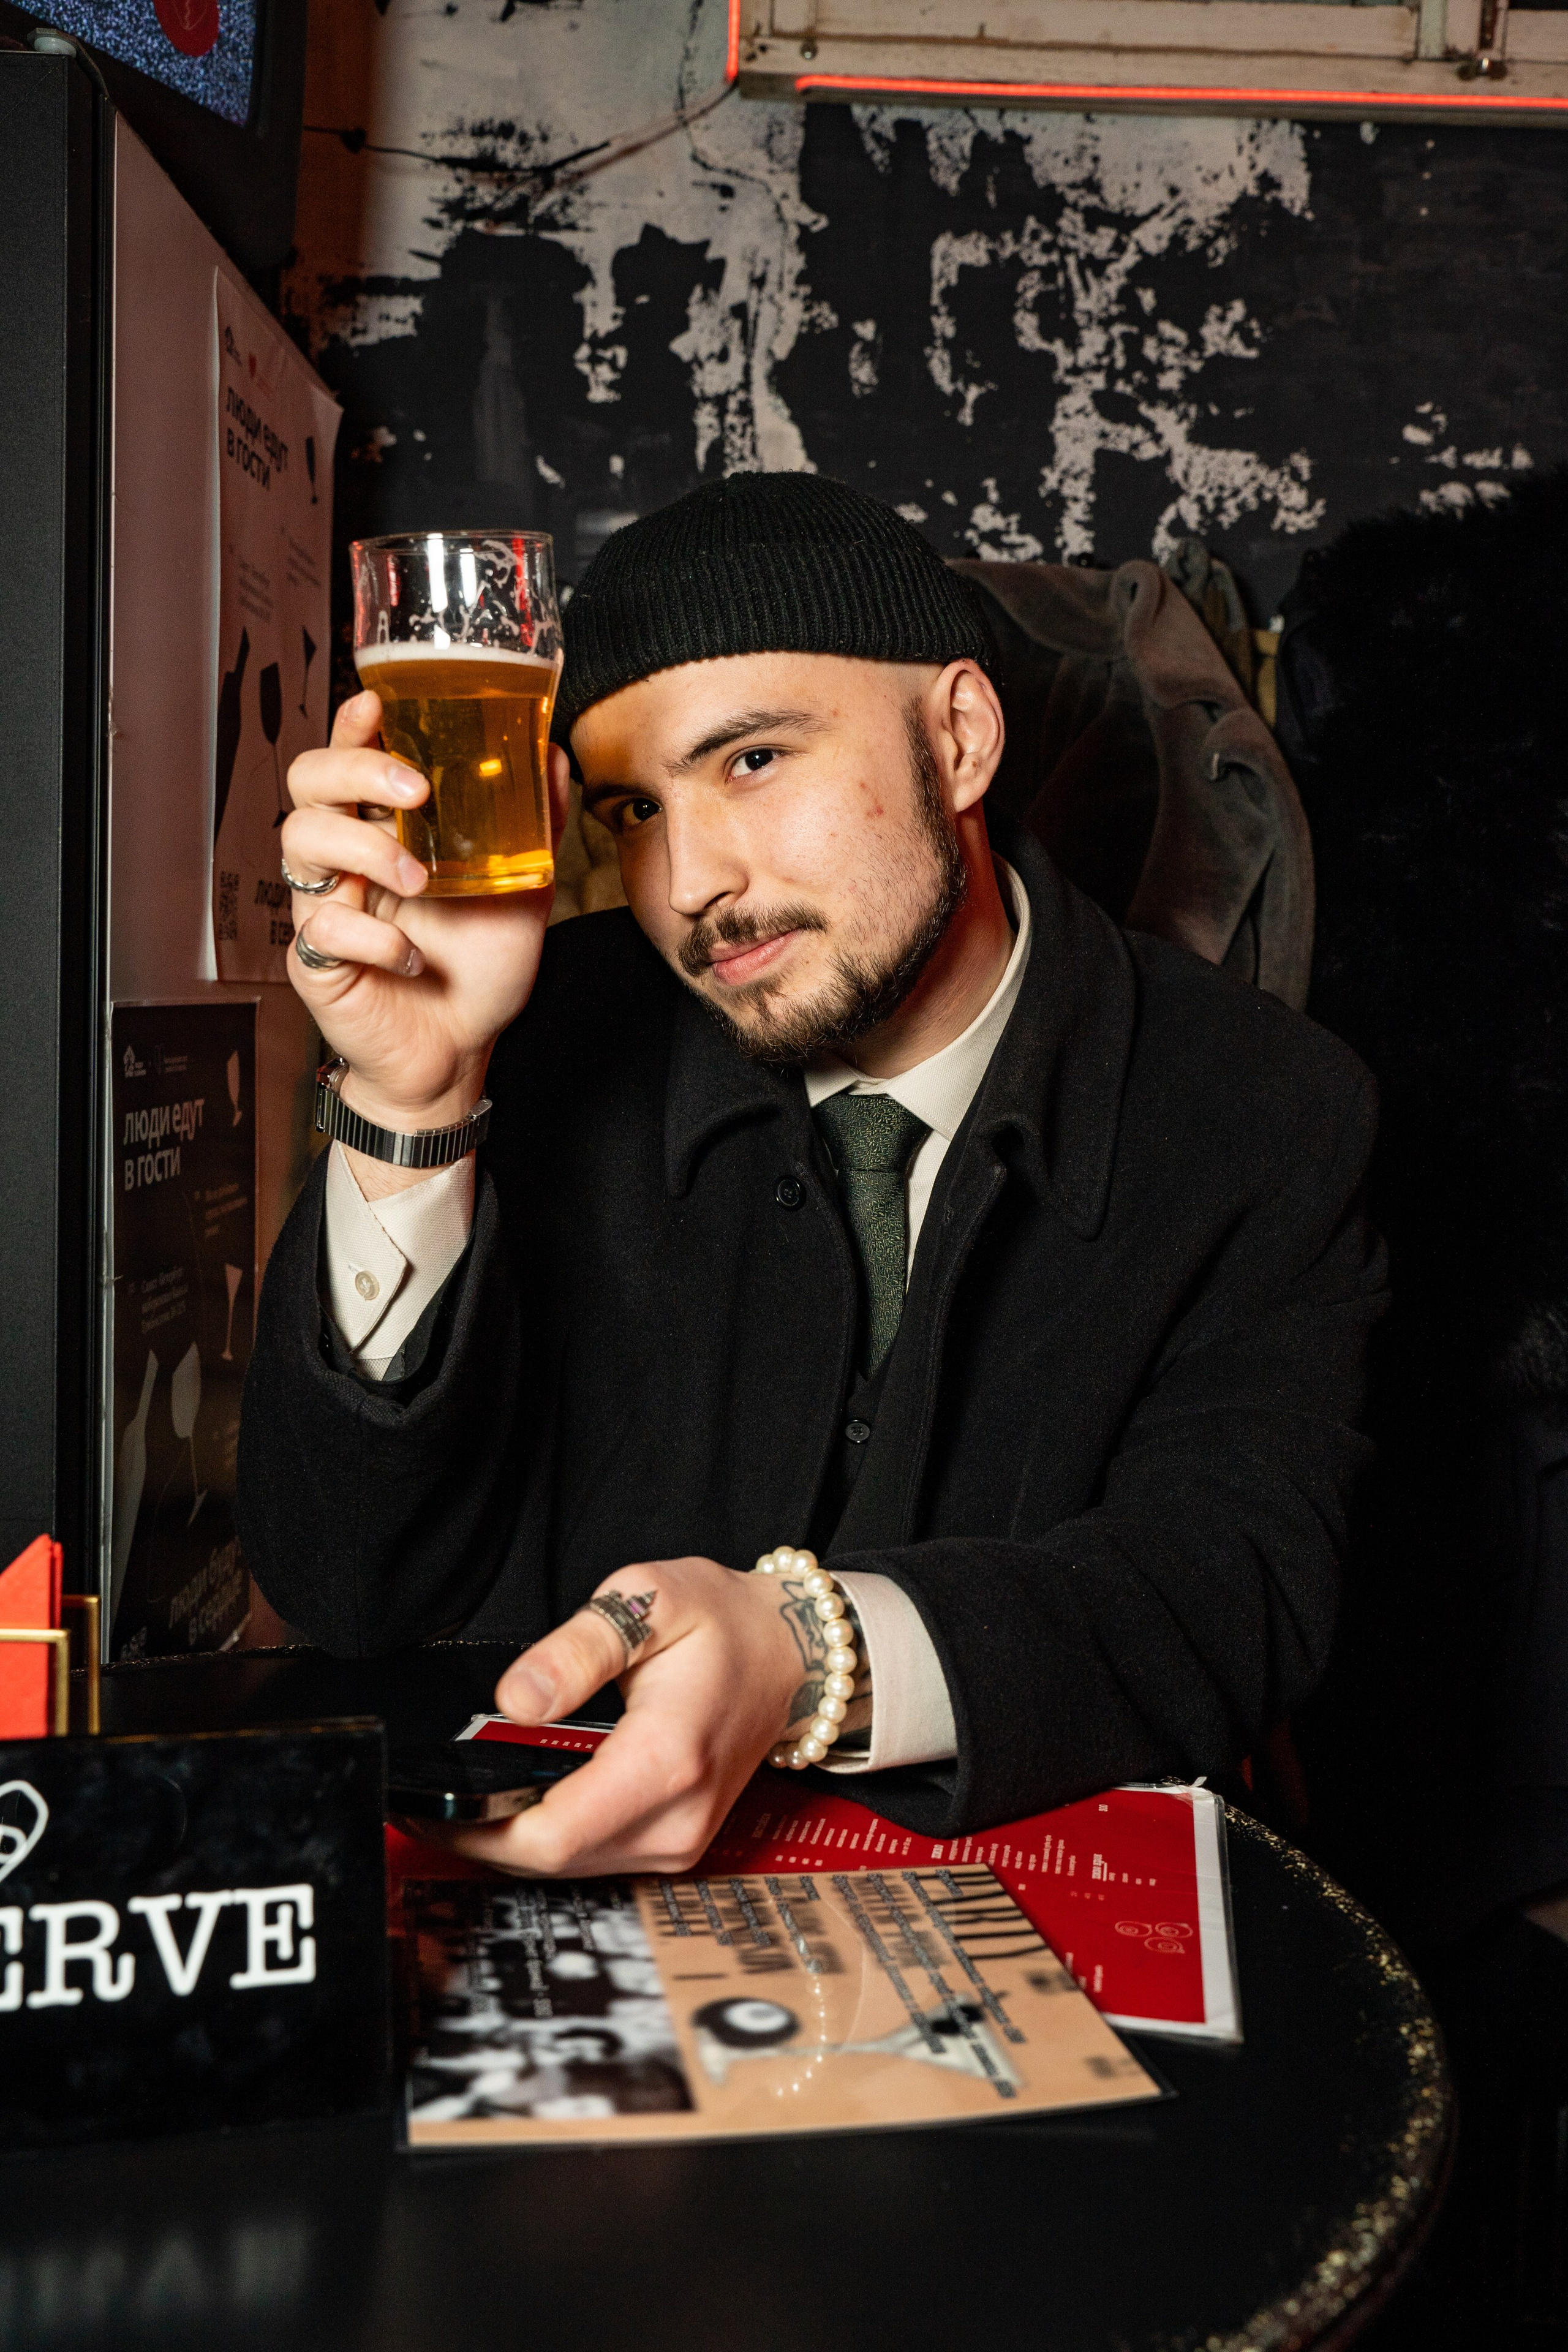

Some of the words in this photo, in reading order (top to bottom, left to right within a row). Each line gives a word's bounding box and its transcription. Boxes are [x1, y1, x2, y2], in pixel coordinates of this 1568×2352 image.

[123, 1105, 170, 1149] люди
[172, 1098, 205, 1142] едут
[124, 1158, 134, 1191] в
[137, 1147, 181, 1187] гости
